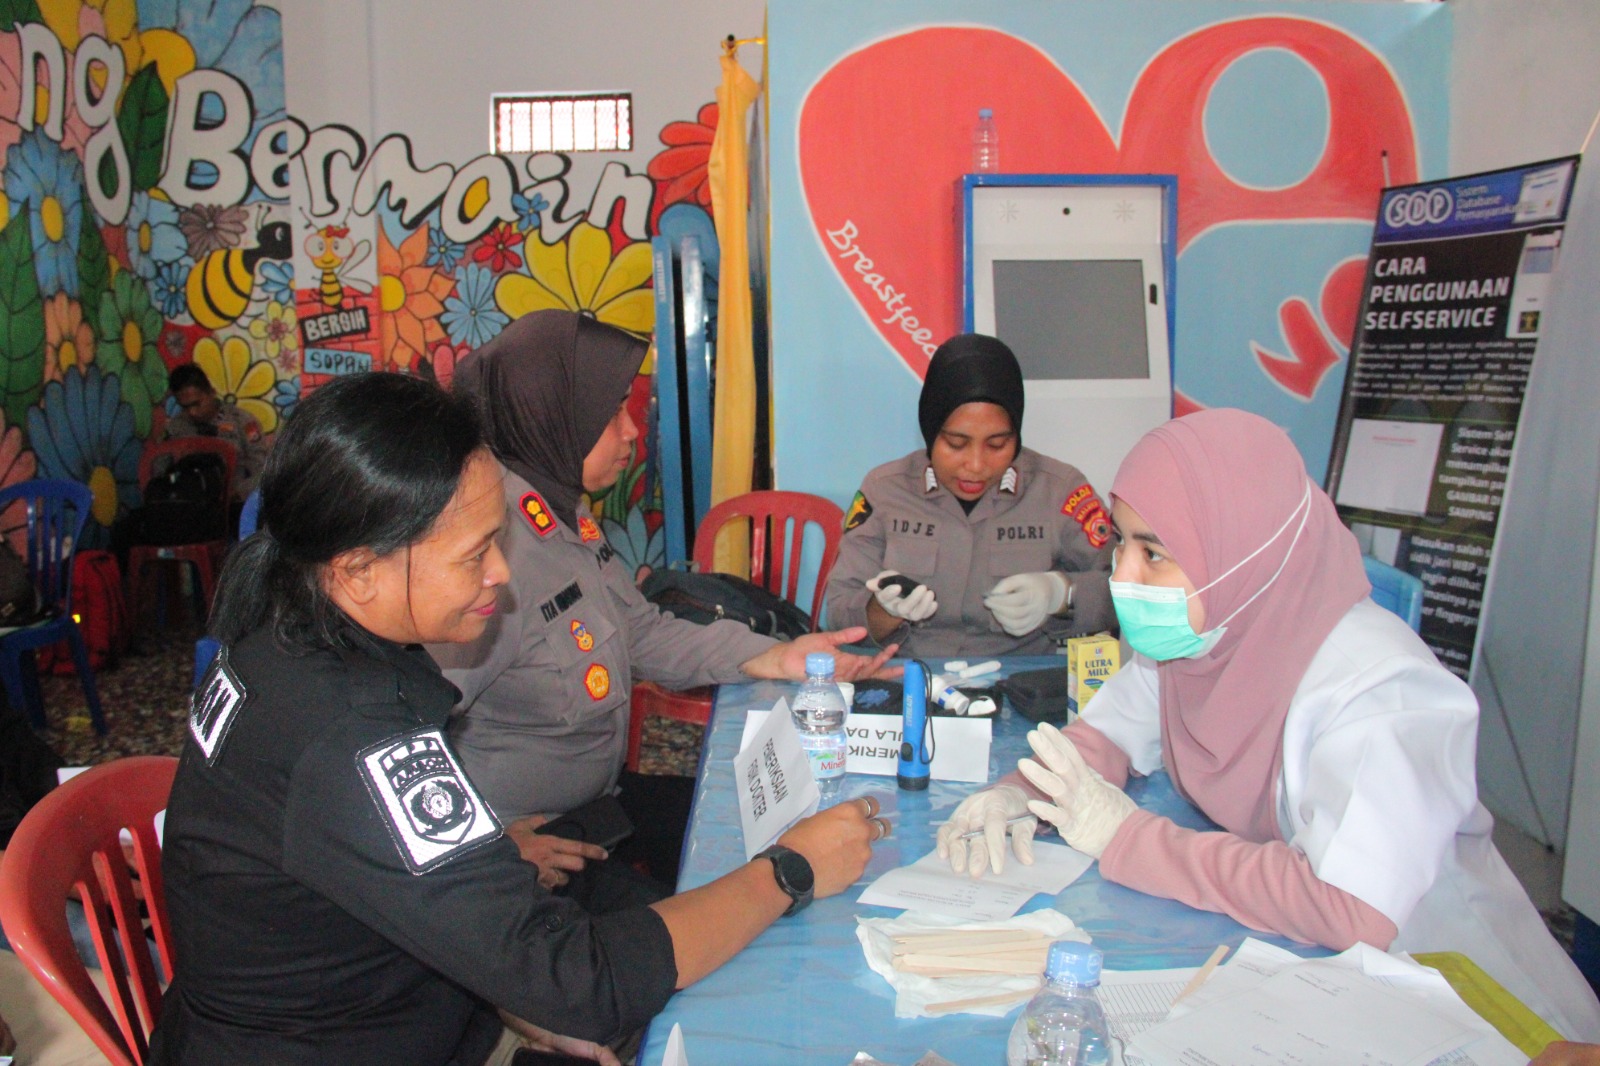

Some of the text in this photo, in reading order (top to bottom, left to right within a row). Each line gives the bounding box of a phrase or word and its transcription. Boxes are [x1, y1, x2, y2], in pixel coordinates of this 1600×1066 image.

[160, 68, 652, 245] Bermain
[1389, 190, 1449, 225] SDP
[1374, 257, 1427, 277] CARA
[1369, 277, 1510, 304] PENGGUNAAN
[304, 308, 367, 341] BERSIH
[1365, 307, 1497, 330] SELFSERVICE
[1458, 427, 1514, 440] Sistem Self
[1451, 443, 1489, 456] Service
[1064, 485, 1092, 514] POLDA
[997, 526, 1044, 541] POLRI
[1085, 659, 1113, 669] ULTRA
[1087, 667, 1110, 677] MILK
[763, 737, 789, 805] PEMERIKSAAN
[749, 778, 768, 822] DOKTER
